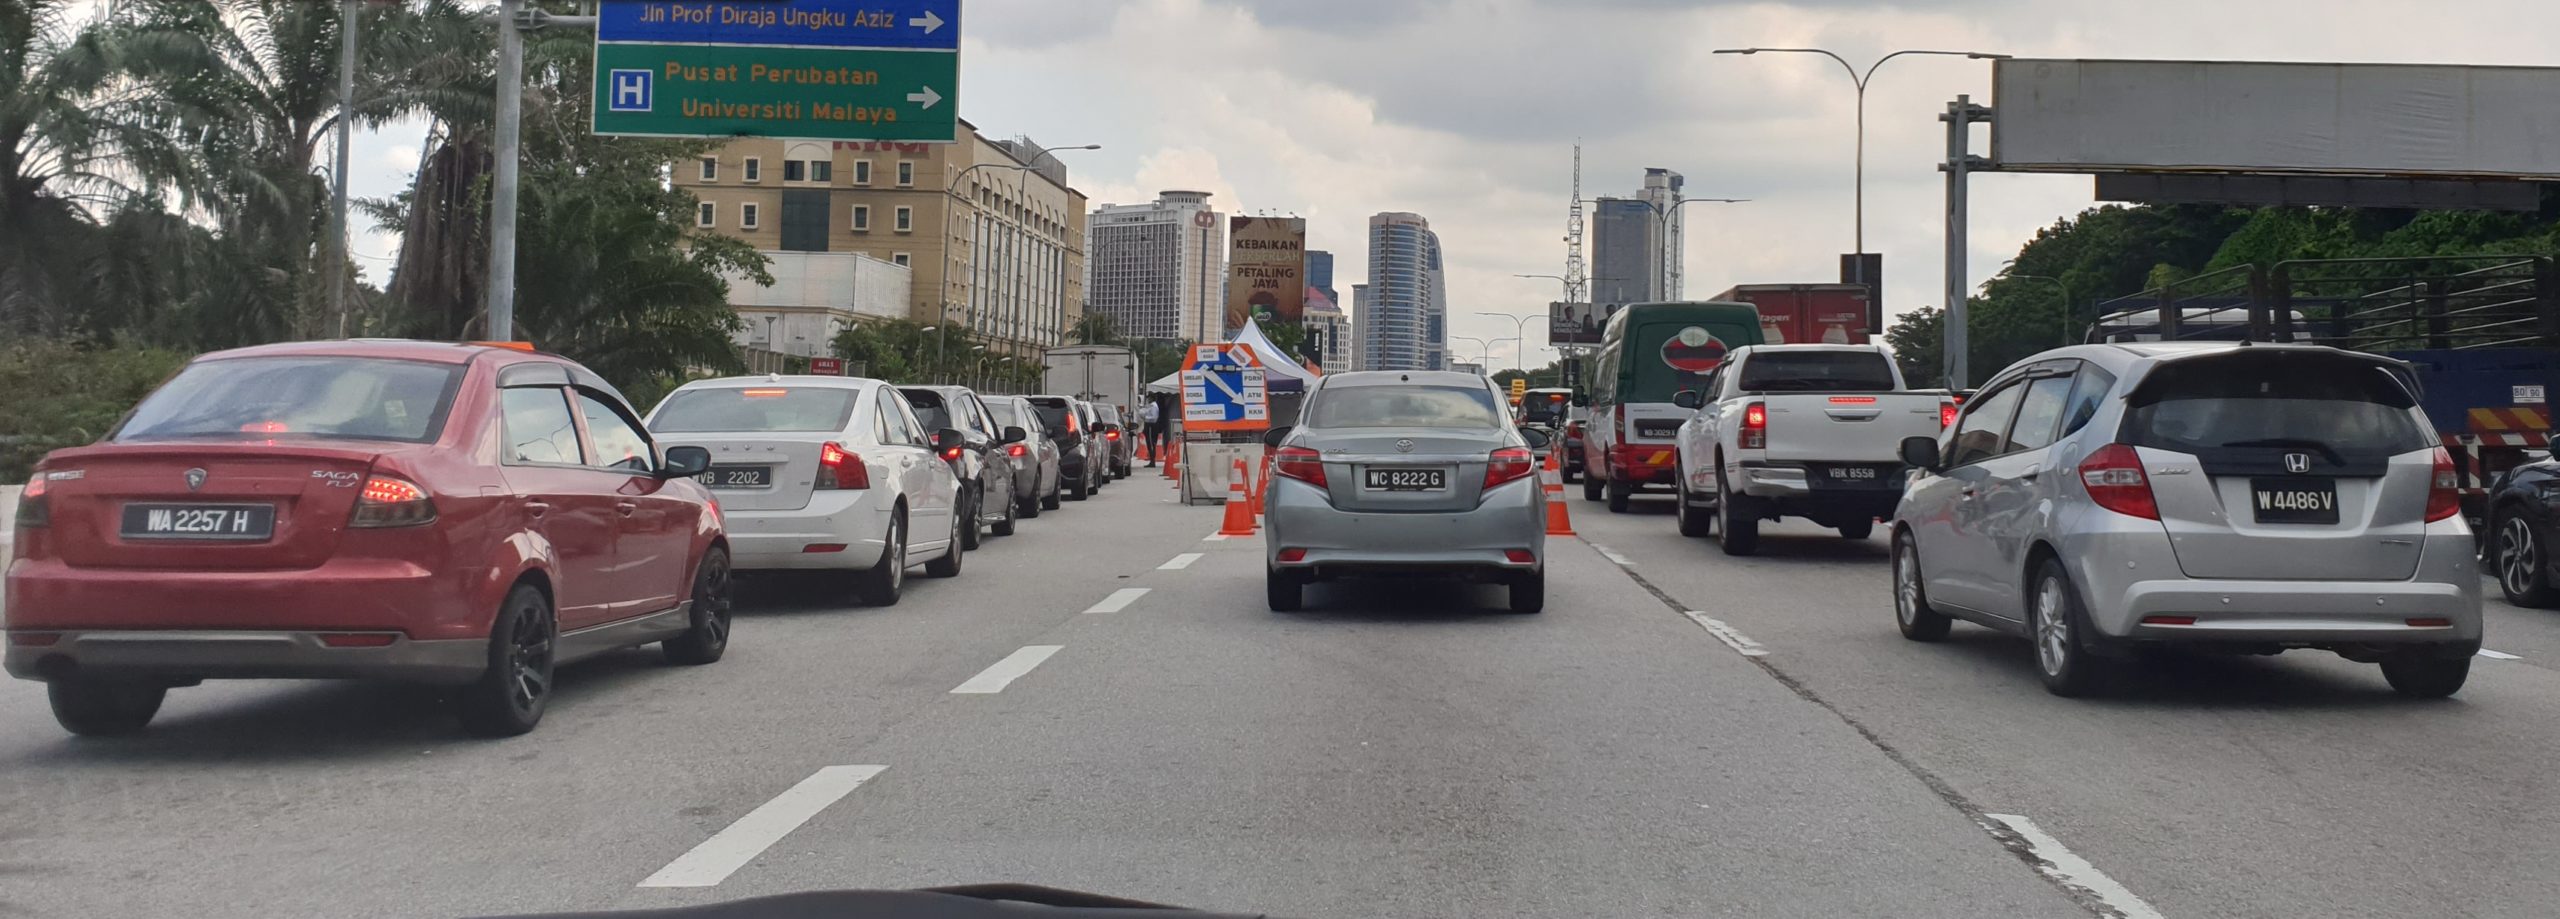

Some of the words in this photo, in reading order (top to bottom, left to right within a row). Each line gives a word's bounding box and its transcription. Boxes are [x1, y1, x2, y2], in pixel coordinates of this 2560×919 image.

[640, 4, 664, 22] Jln
[672, 5, 712, 23] Prof
[721, 6, 776, 28] Diraja
[783, 8, 845, 29] Ungku
[854, 9, 894, 28] Aziz
[666, 62, 737, 81] Pusat
[751, 64, 878, 84] Perubatan
[619, 76, 643, 105] H
[683, 98, 800, 119] Universiti
[813, 102, 896, 125] Malaya
[1236, 239, 1298, 250] KEBAIKAN
[1237, 267, 1295, 278] PETALING
[1252, 279, 1279, 289] JAYA
[312, 470, 359, 480] SAGA
[727, 471, 760, 484] 2202
[1371, 472, 1388, 485] WC
[1392, 472, 1427, 486] 8222
[1431, 472, 1439, 485] G
[1829, 468, 1847, 478] VBK
[1850, 468, 1875, 478] 8558
[2257, 491, 2271, 510] W
[2274, 491, 2320, 510] 4486
[2320, 491, 2332, 510] V
[148, 510, 171, 531] WA
[174, 510, 227, 532] 2257
[232, 511, 249, 532] H
